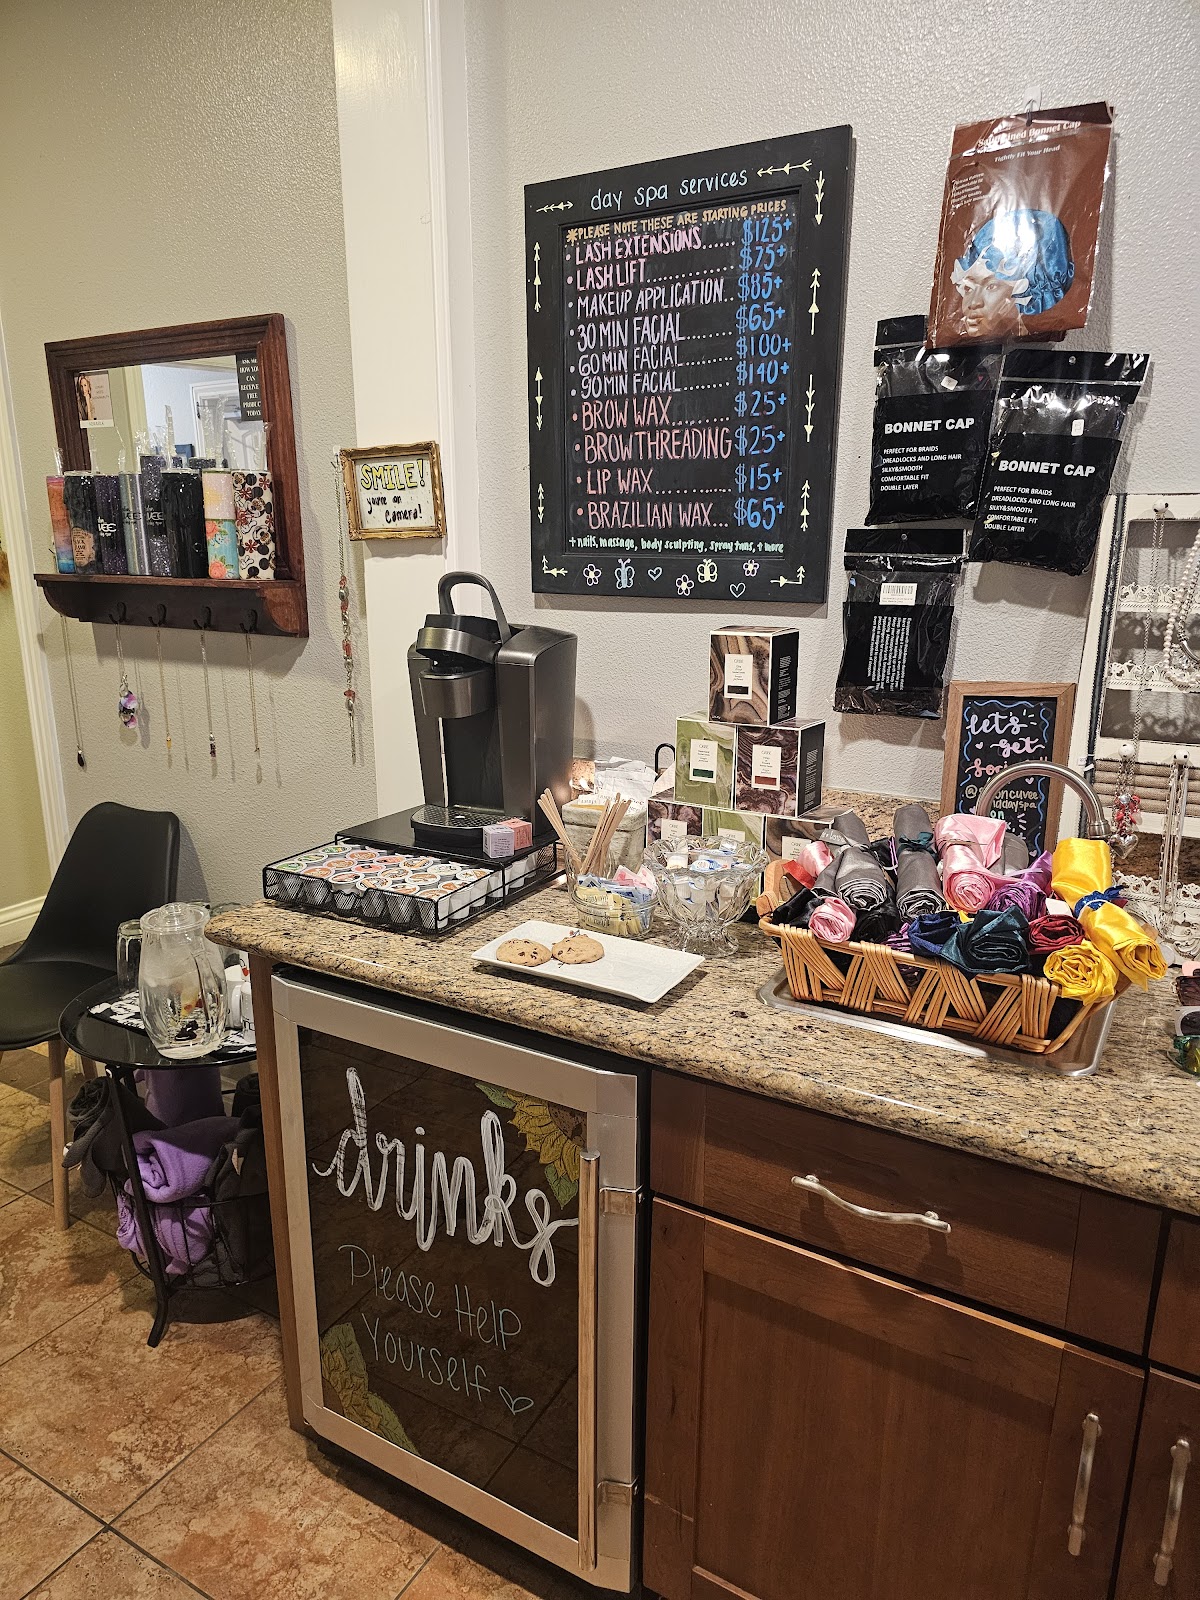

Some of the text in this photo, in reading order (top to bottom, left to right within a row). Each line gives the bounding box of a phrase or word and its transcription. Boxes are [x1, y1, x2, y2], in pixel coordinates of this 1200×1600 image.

[1029, 123, 1061, 138] Bonnet
[1063, 121, 1081, 131] Cap
[1027, 149, 1042, 157] Your
[1043, 144, 1061, 154] Head
[590, 169, 748, 211] day spa services
[614, 223, 638, 235] NOTE
[640, 215, 674, 232] THESE
[677, 212, 698, 226] ARE
[702, 206, 749, 223] STARTING
[751, 200, 787, 214] PRICES
[575, 216, 792, 265] LASH EXTENSIONS $125+
[576, 243, 786, 291] LASH LIFT $75+
[577, 271, 783, 319] MAKEUP APPLICATION $85+
[577, 302, 786, 352] 30 MIN FACIAL $65+
[578, 333, 792, 376] 60 MIN FACIAL $100+
[580, 359, 790, 399] 90 MIN FACIAL $140+
[242, 400, 262, 408] PRODUC
[246, 392, 258, 400] FREE
[581, 390, 787, 432] BROW WAX $25+
[884, 417, 975, 435] BONNET CAP
[584, 425, 786, 464] BROW THREADING $25+
[883, 447, 905, 455] PERFECT
[918, 445, 939, 453] BRAIDS
[881, 465, 923, 473] SILKY&SMOOTH
[882, 456, 917, 464] DREADLOCKS
[998, 459, 1096, 477] BONNET CAP
[360, 458, 426, 490] SMILE!
[586, 463, 783, 495] LIP WAX $15+
[880, 474, 920, 483] COMFORTABLE
[880, 483, 919, 492] DOUBLE LAYER
[993, 485, 1017, 493] PERFECT
[1030, 488, 1053, 496] BRAIDS
[392, 495, 402, 504] on
[988, 504, 1034, 514] SILKY&SMOOTH
[991, 495, 1028, 504] DREADLOCKS
[1028, 497, 1042, 505] AND
[1042, 499, 1060, 507] LONG
[587, 496, 785, 530] BRAZILIAN WAX $65+
[986, 513, 1028, 524] COMFORTABLE
[984, 523, 1025, 533] DOUBLE LAYER
[577, 534, 599, 549] nails,
[599, 537, 638, 552] massage,
[641, 537, 662, 552] body
[664, 538, 708, 553] sculpting,
[709, 540, 733, 553] spray
[965, 710, 1028, 735] let's
[989, 736, 1046, 758] get
[312, 1067, 579, 1288] drinks
[338, 1244, 522, 1350] Please Help
[361, 1312, 491, 1402] Yourself
